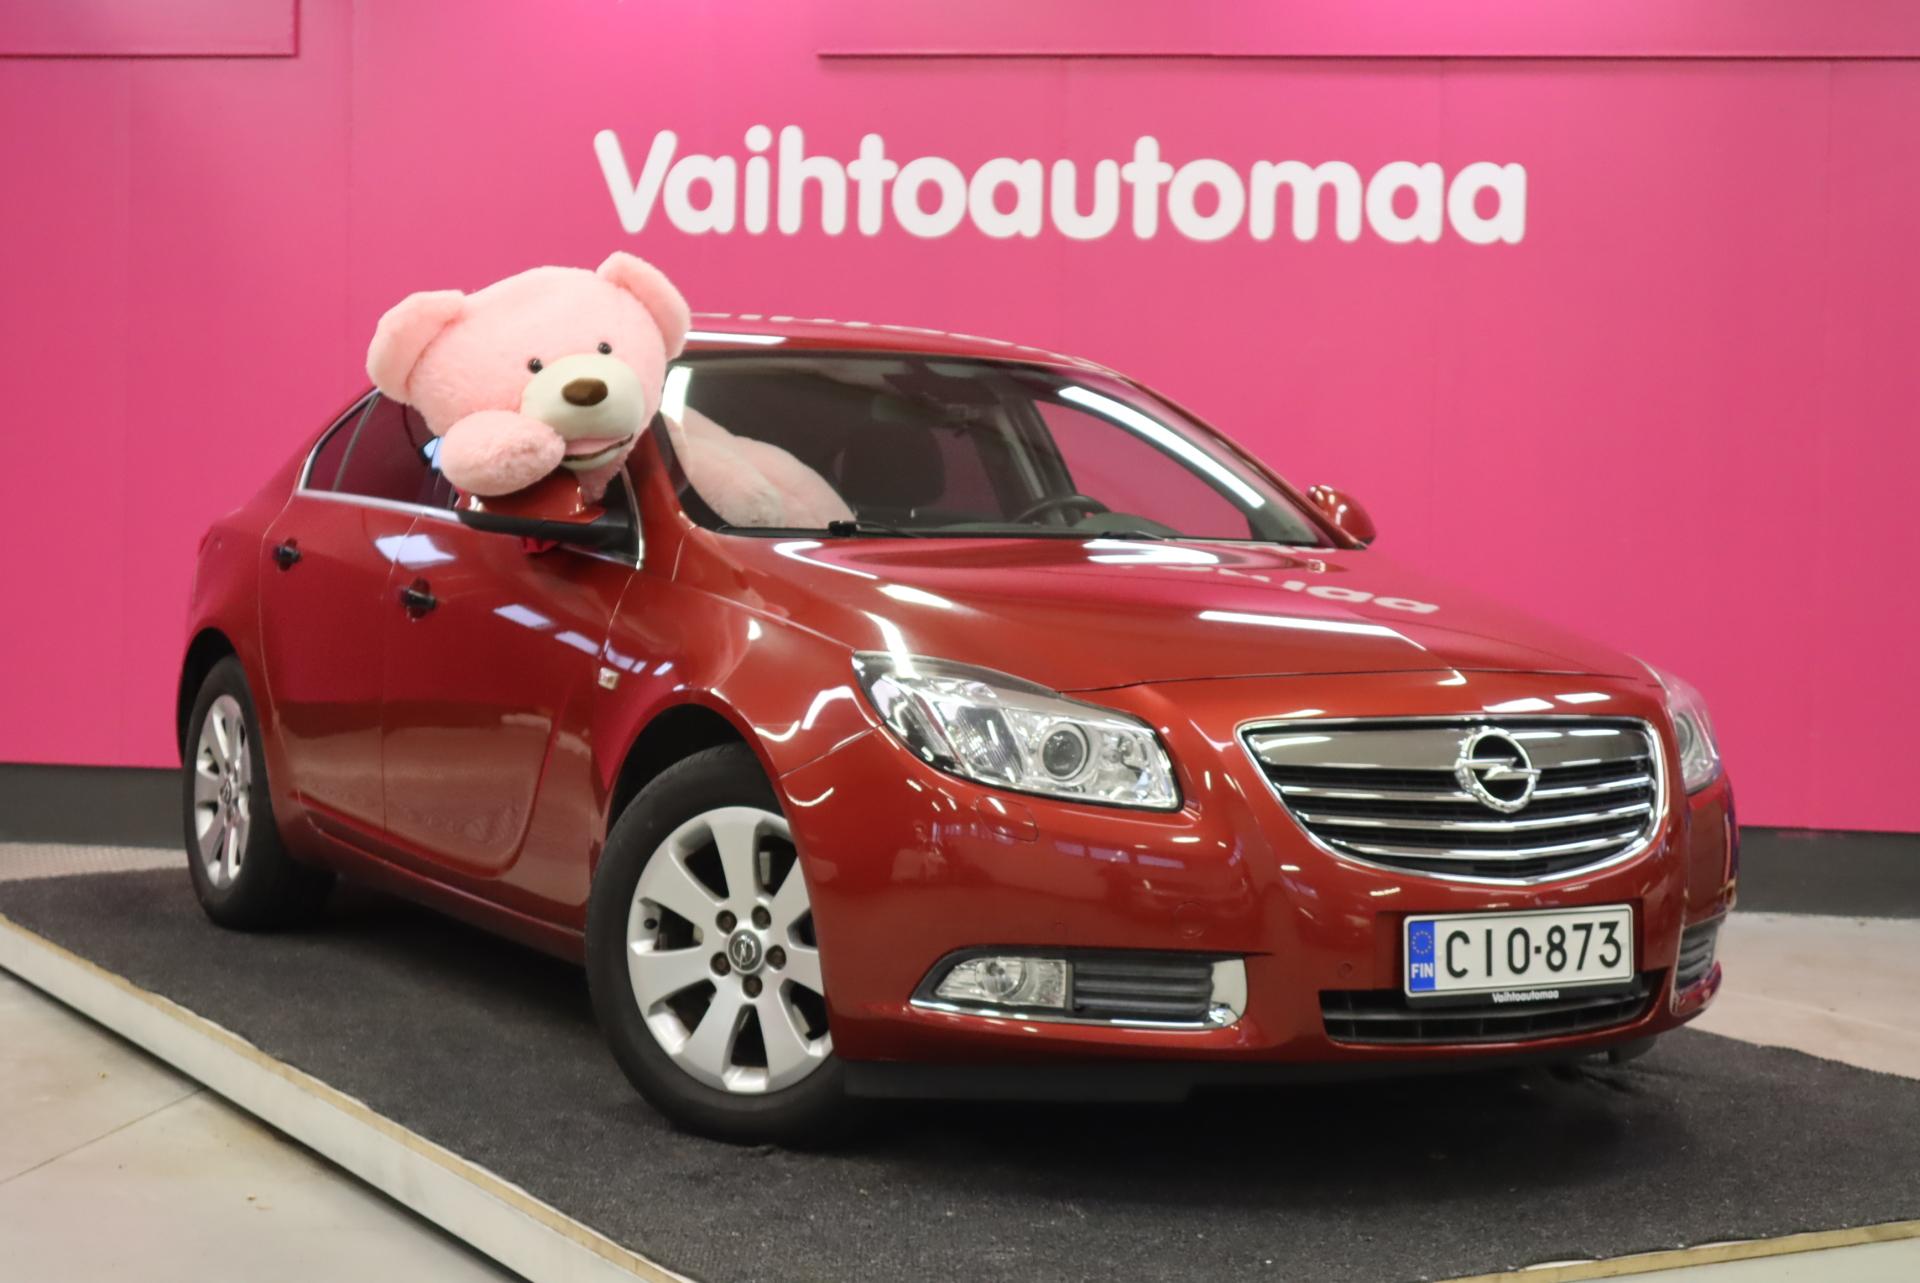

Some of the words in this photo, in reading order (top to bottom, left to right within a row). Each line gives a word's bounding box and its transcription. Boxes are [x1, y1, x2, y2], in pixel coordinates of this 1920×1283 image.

[593, 124, 1527, 245] Vaihtoautomaa
[1411, 963, 1434, 979] FIN
[1492, 989, 1560, 1003] Vaihtoautomaa
